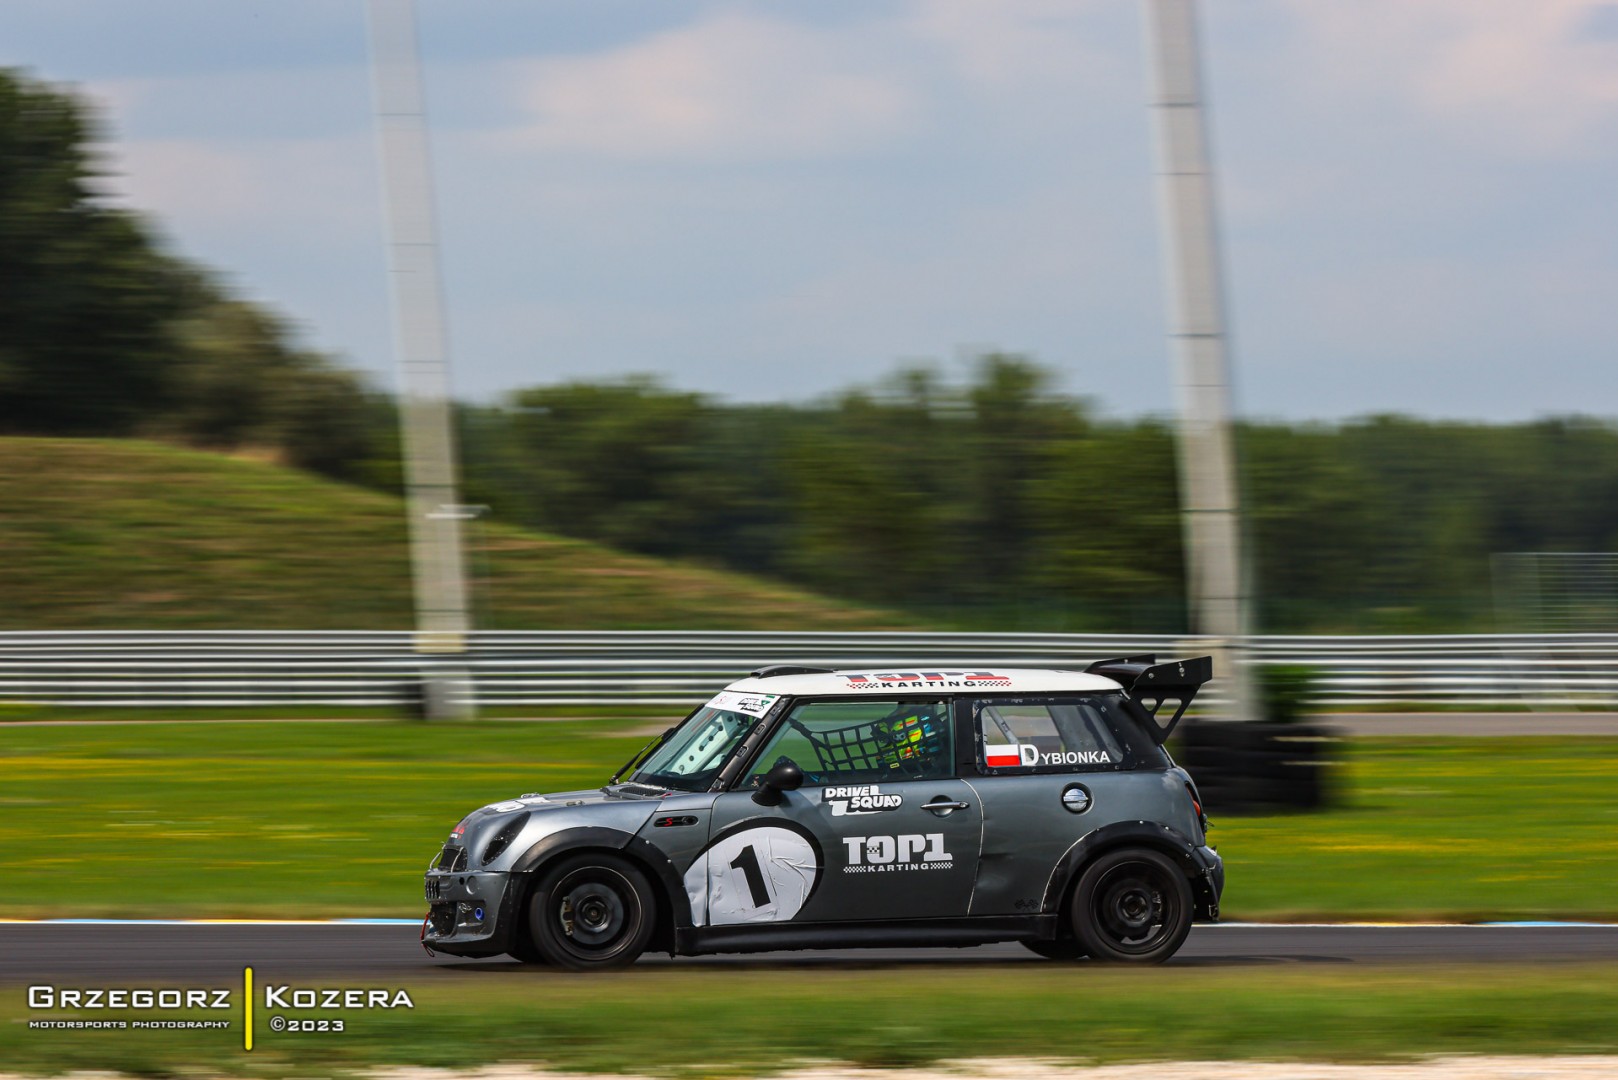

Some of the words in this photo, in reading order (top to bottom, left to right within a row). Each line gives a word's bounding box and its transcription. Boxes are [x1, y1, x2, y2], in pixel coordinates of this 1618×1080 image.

[881, 680, 976, 689] KARTING
[1020, 743, 1111, 767] DYBIONKA
[851, 795, 902, 809] SQUAD
[663, 817, 673, 827] S
[842, 833, 953, 865] TOP1
[867, 863, 929, 873] KARTING
[730, 844, 771, 908] 1
